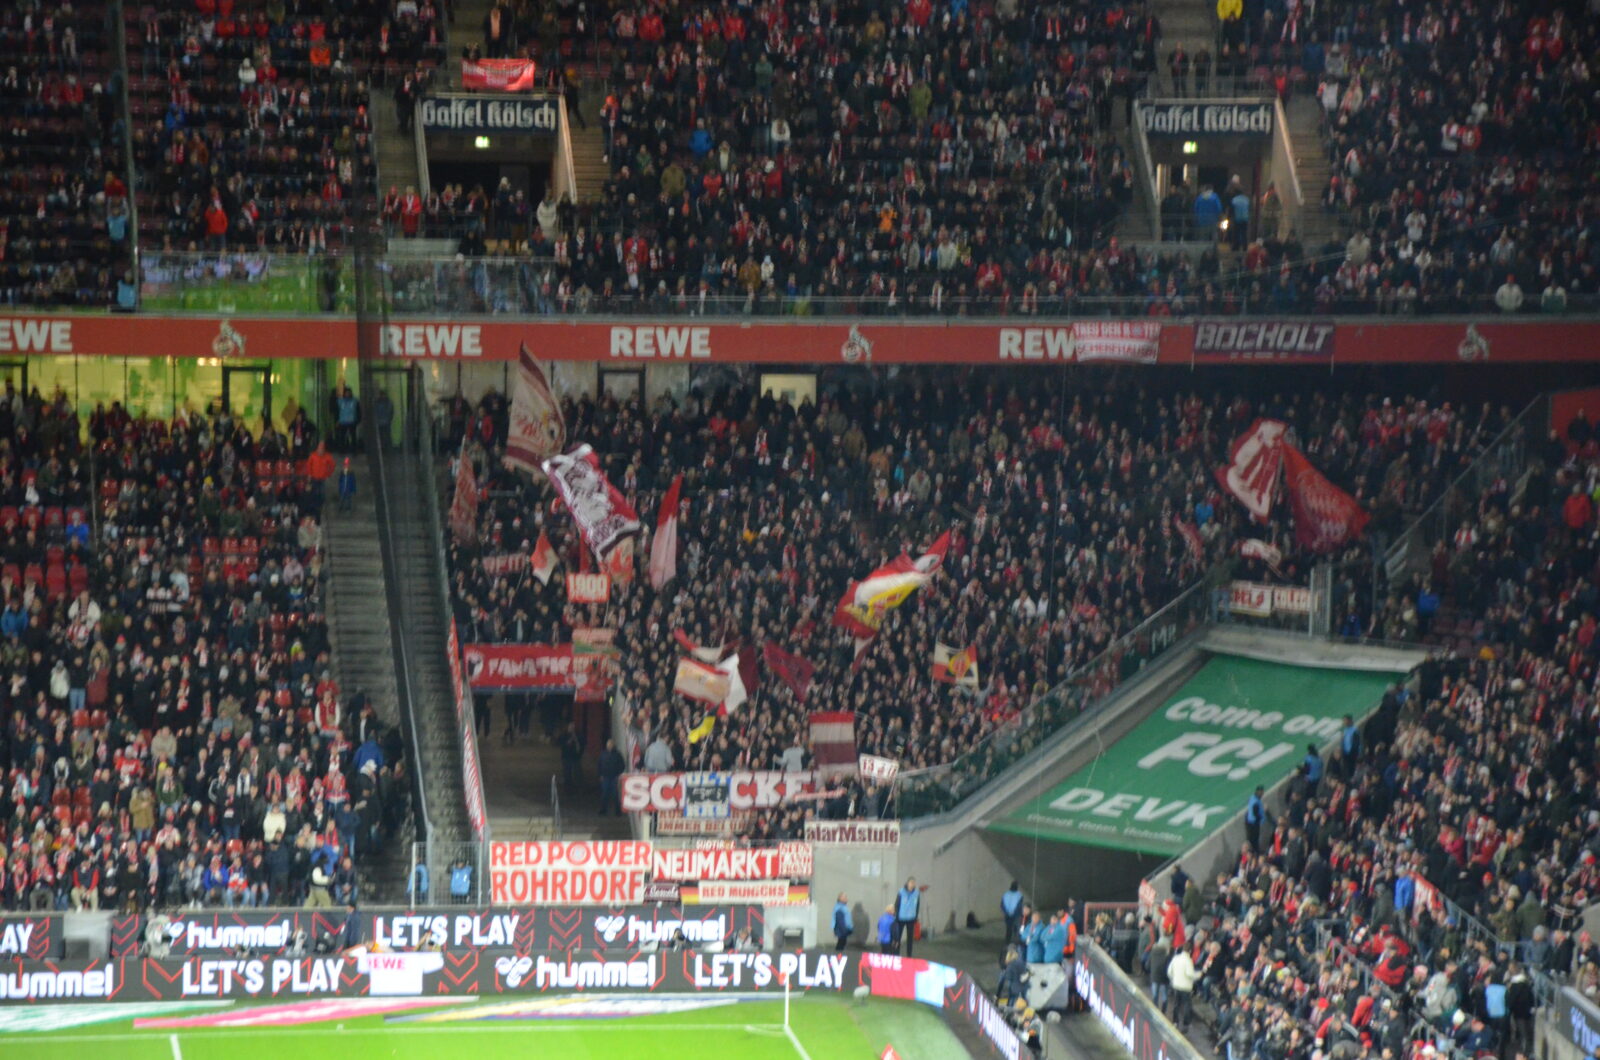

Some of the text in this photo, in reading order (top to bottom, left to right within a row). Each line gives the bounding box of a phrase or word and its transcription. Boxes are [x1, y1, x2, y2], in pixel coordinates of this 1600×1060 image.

[379, 325, 482, 356] REWE
[610, 326, 711, 357] REWE
[999, 328, 1075, 360] REW
[1194, 323, 1333, 352] BOCHOLT
[569, 574, 608, 598] 1900
[1165, 697, 1283, 730] Come
[1137, 732, 1295, 780] FC!
[1049, 787, 1227, 829] DEVK
[491, 841, 651, 866] RED POWER
[653, 849, 778, 879] NEUMARKT
[491, 869, 644, 902] ROHRDORF
[187, 920, 289, 948] hummel
[376, 915, 520, 946] LET'S PLAY
[628, 914, 725, 942] hummel
[183, 958, 345, 995] LET'S PLAY
[536, 955, 656, 988] hummel
[694, 952, 848, 988] LET'S PLAY
